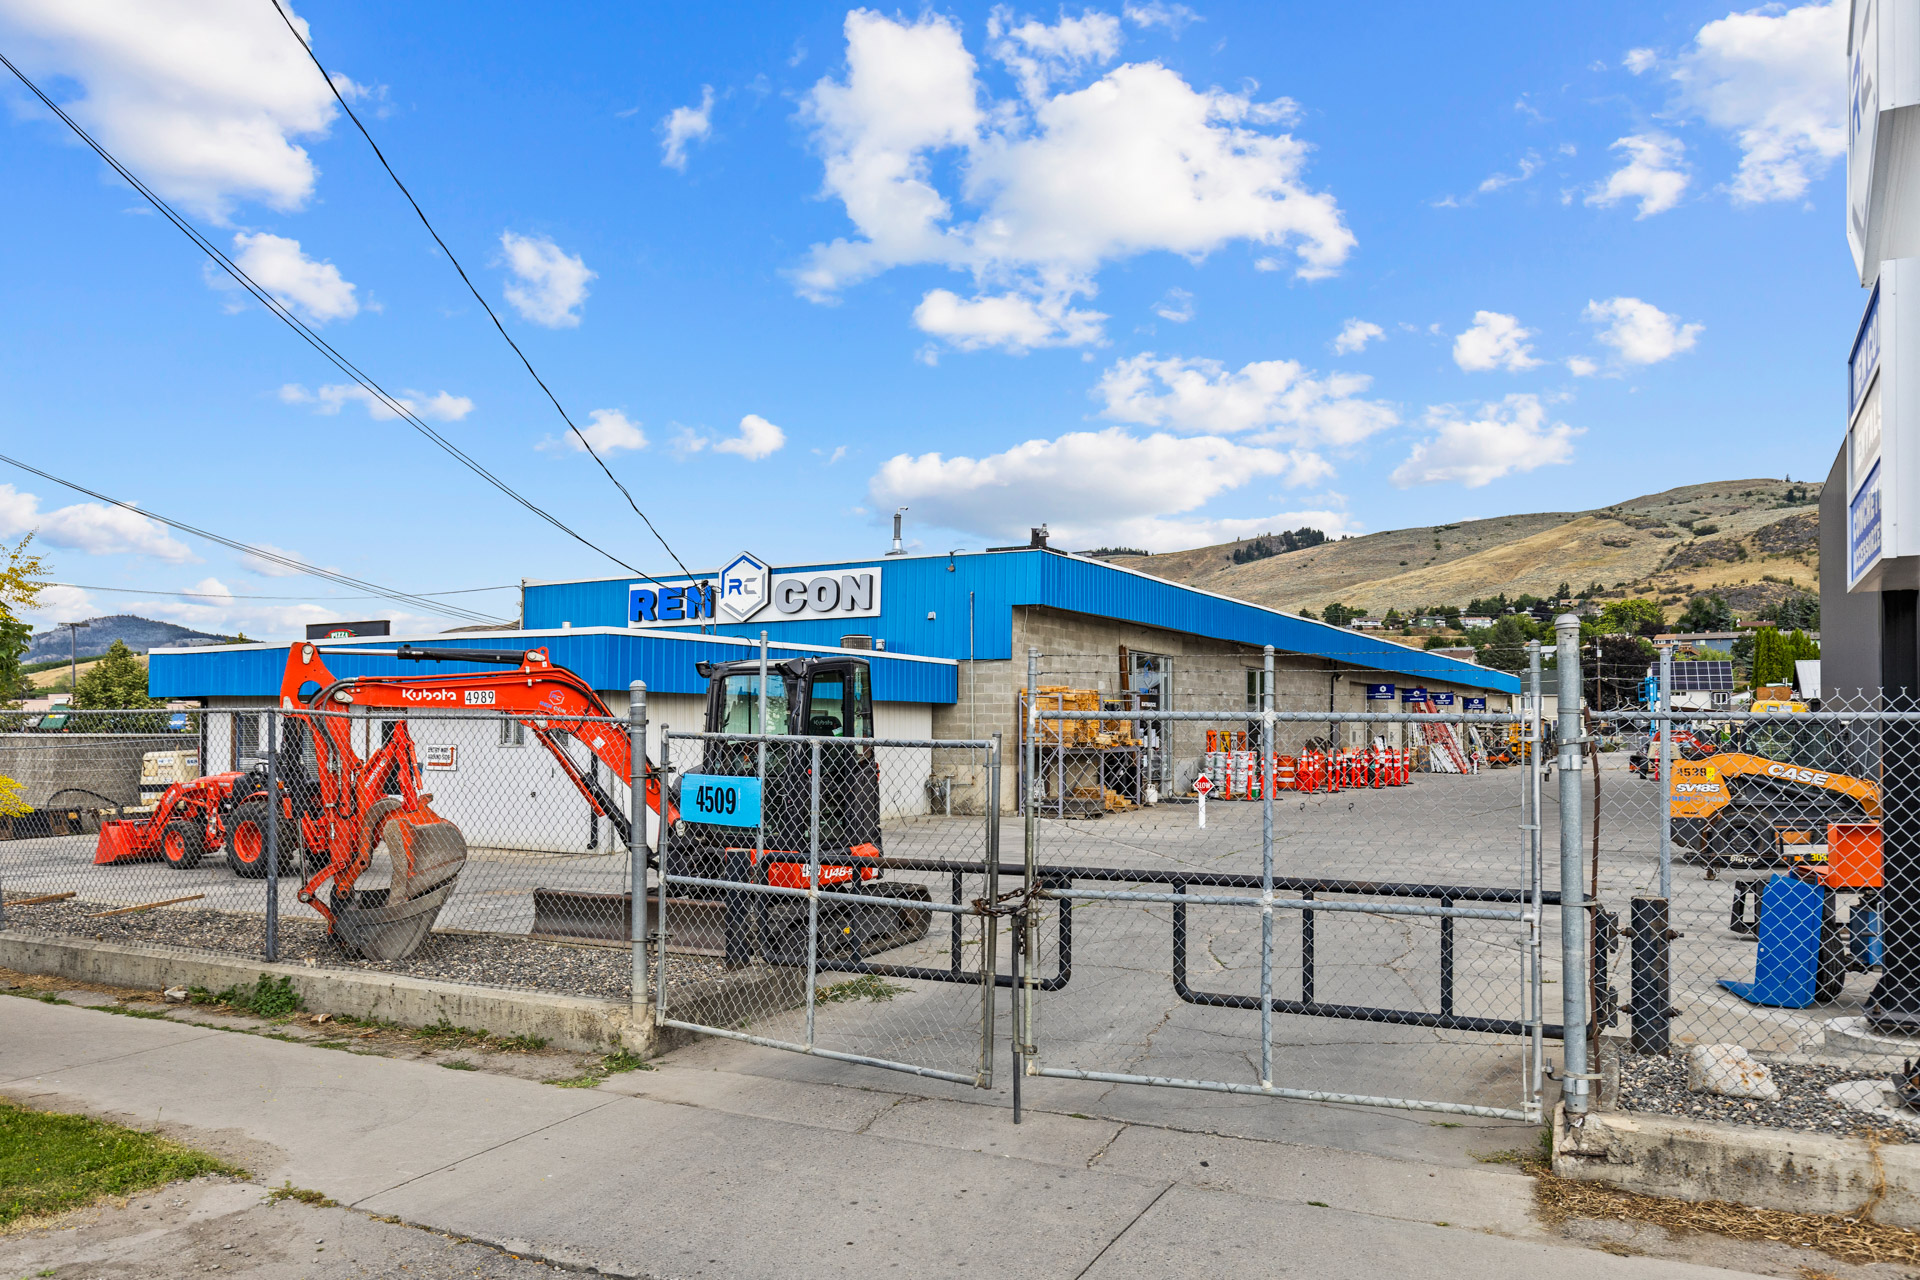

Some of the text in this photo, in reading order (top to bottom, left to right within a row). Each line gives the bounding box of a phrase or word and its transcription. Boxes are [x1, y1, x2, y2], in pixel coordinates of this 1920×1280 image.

[728, 577, 758, 596] RC
[629, 573, 873, 623] REN CON
[330, 631, 349, 639] PIZZA
[402, 688, 457, 701] Kubota
[465, 690, 495, 704] 4989
[813, 718, 834, 727] Kubota
[1767, 764, 1830, 787] CASE
[1196, 781, 1211, 789] SLOW
[1675, 783, 1720, 793] SV185
[695, 785, 737, 815] 4509
